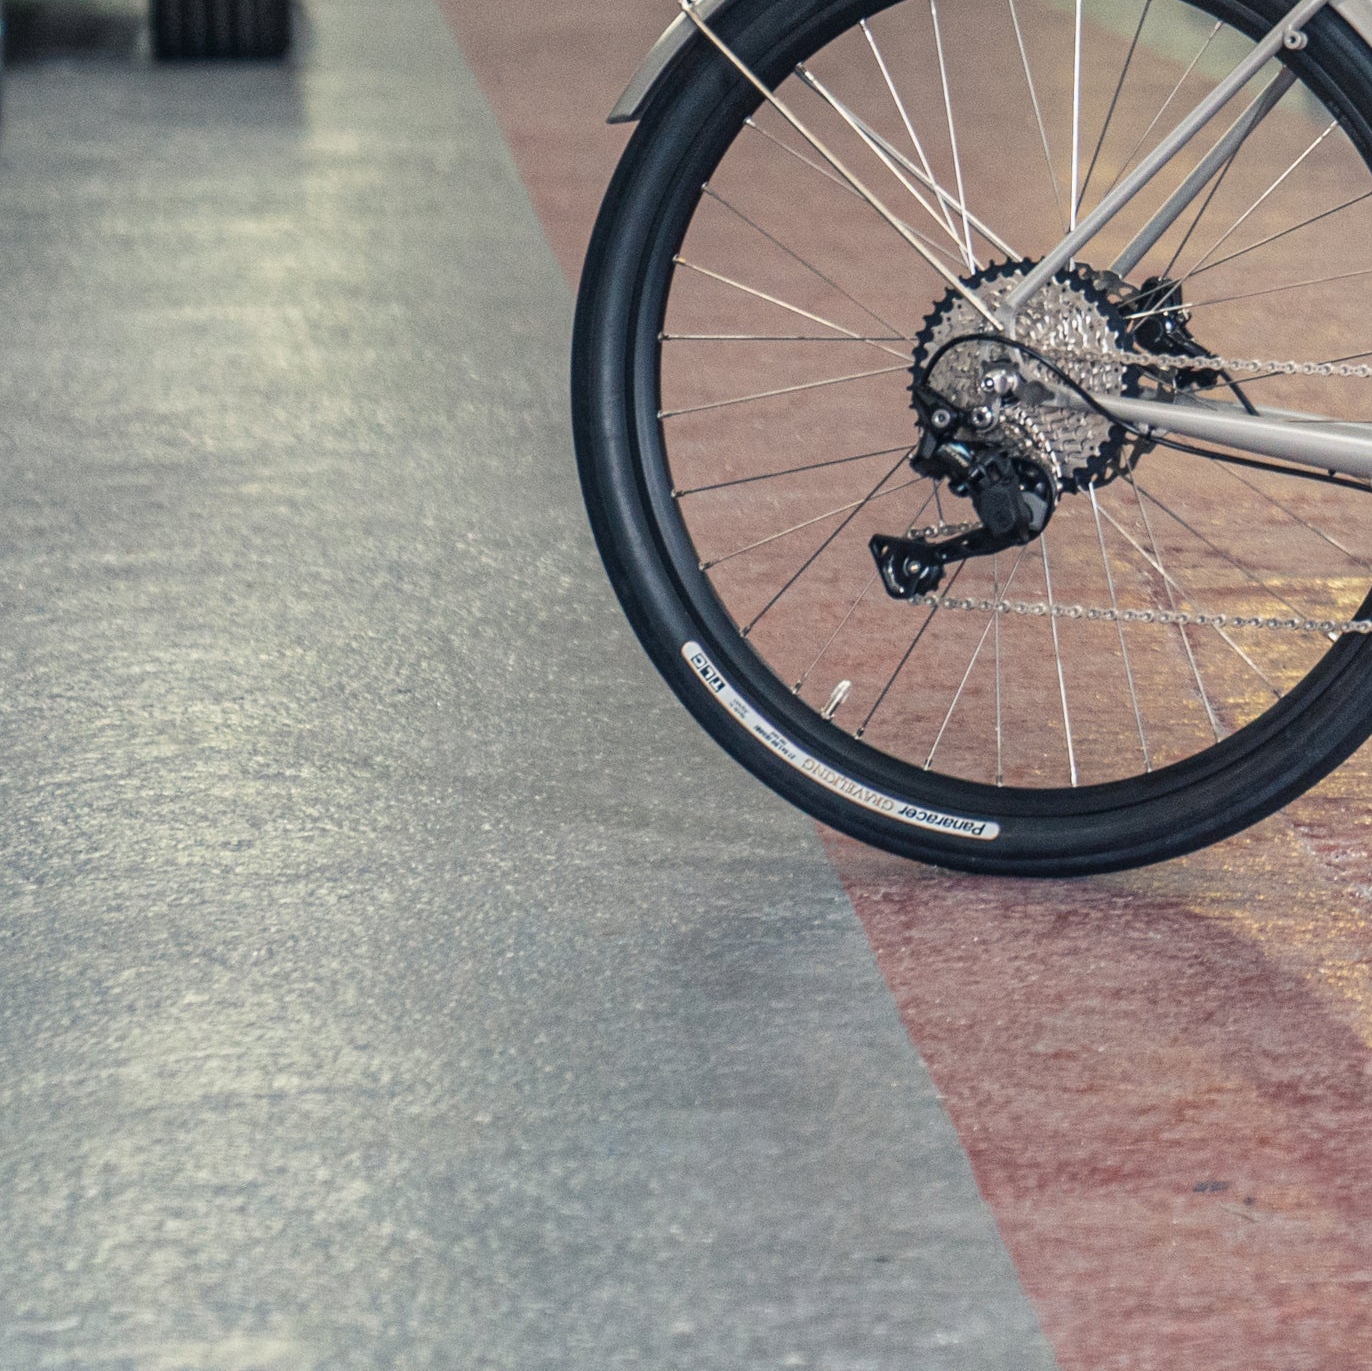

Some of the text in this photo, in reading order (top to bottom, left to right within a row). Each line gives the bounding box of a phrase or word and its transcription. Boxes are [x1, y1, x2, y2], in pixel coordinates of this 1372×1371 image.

[690, 653, 725, 693] TLC
[802, 758, 986, 836] Panaracer GRAVELKING
